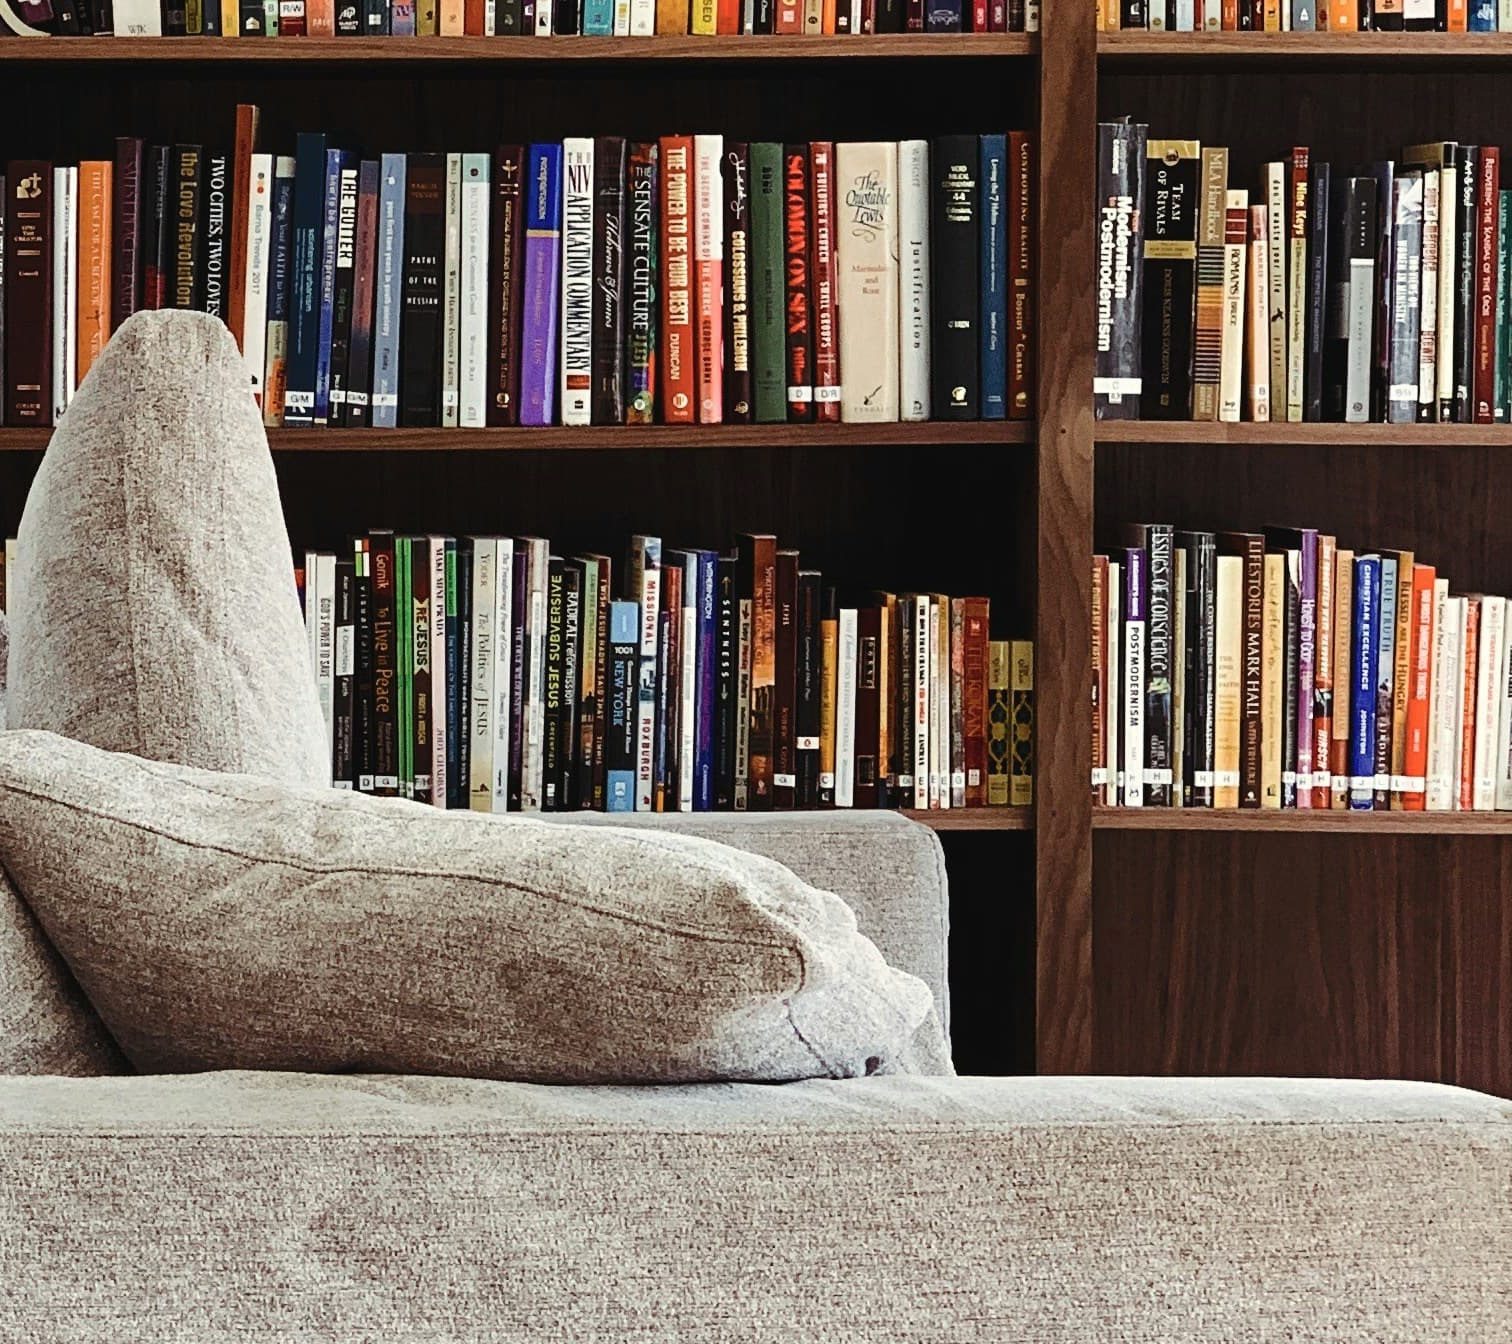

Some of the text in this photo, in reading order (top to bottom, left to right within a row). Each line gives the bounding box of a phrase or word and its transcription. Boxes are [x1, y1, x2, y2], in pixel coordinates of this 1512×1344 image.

[177, 152, 197, 305] the Love Revolution
[207, 157, 224, 315] TWO CITIES, TWO LOVES
[633, 181, 650, 329] SENSATE CULTURE
[668, 147, 688, 380] THE POWER TO BE YOUR BEST! DUNCAN
[1114, 196, 1132, 298] Modernism
[1206, 153, 1221, 241] MLA Handbook
[910, 241, 922, 349] Justification
[1097, 207, 1115, 351] Postmodernism
[1130, 627, 1140, 727] POSTMODERNISM
[1247, 541, 1262, 718] LIFESTORIES MARK HALL
[1361, 564, 1371, 690] CHRISTIAN EXCELLENCE
[1382, 571, 1393, 653] TRUE TRUTH
[613, 660, 624, 726] NEW YORK
[641, 581, 656, 781] MISSIONAL ROXBURGH
